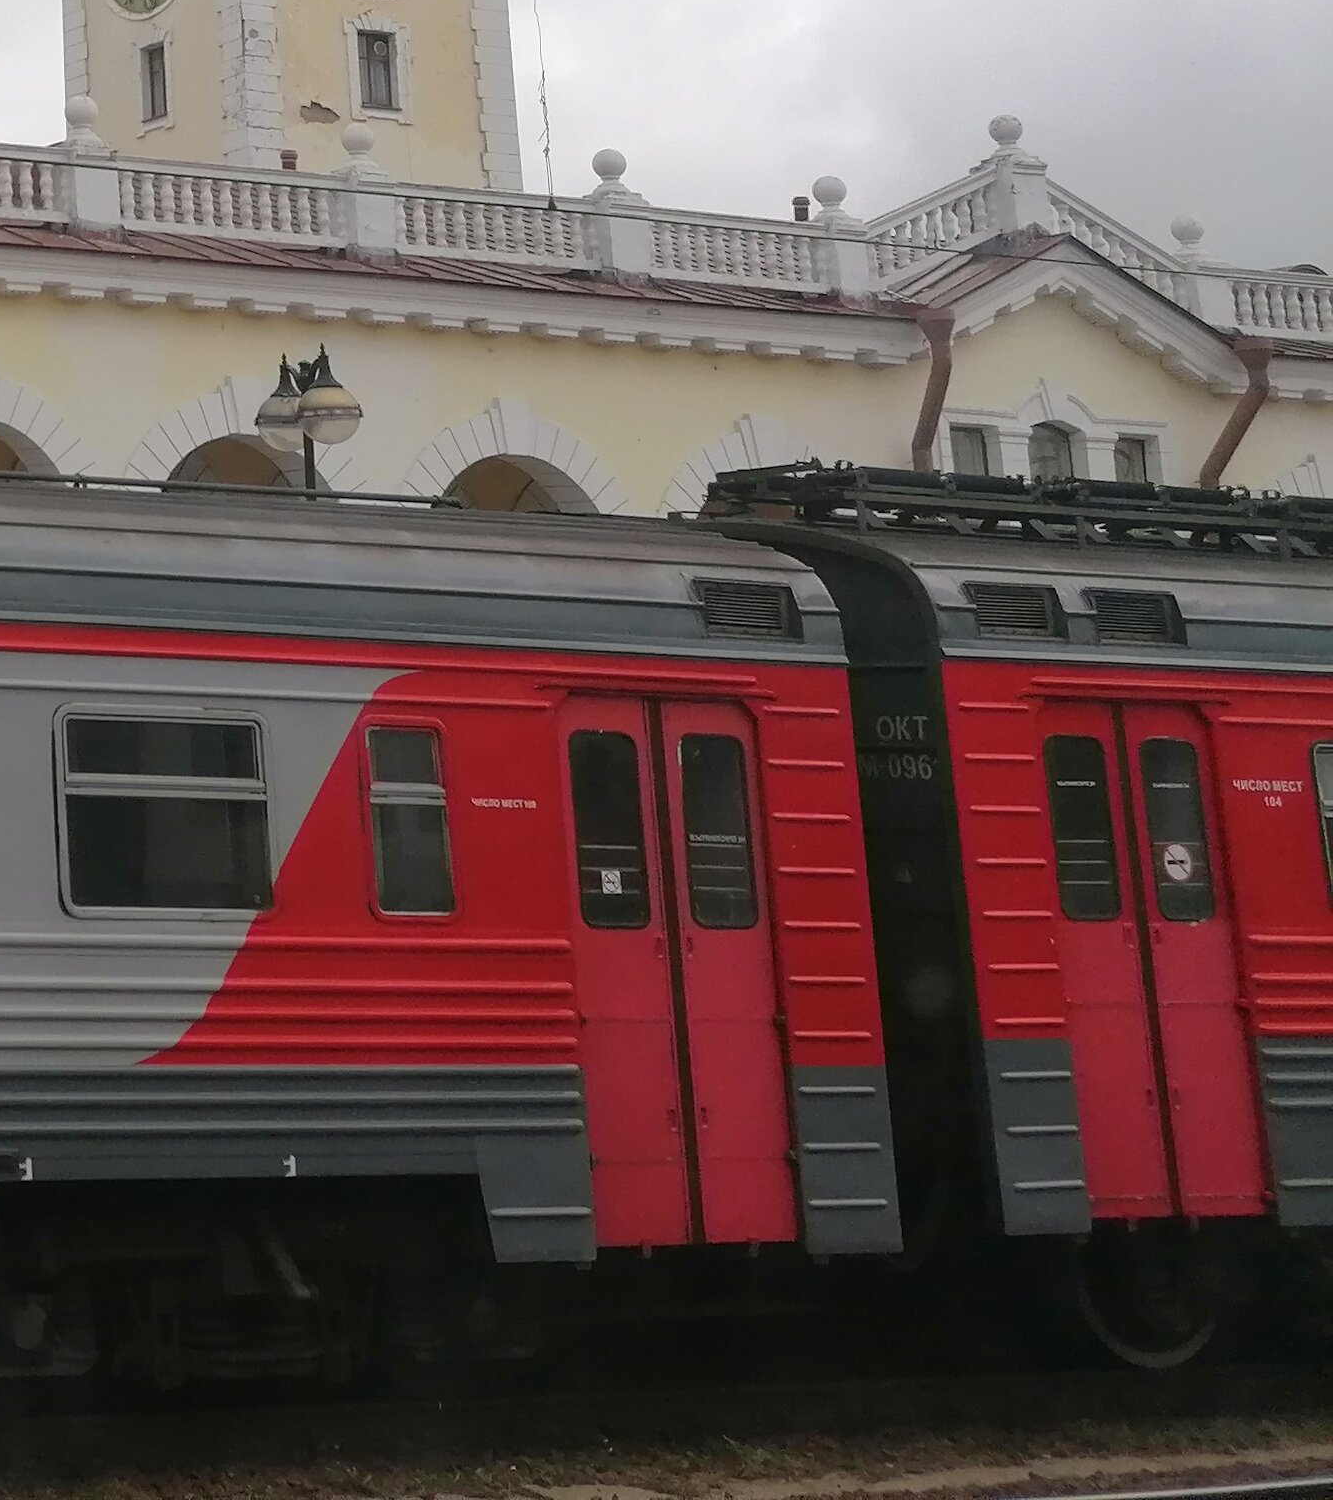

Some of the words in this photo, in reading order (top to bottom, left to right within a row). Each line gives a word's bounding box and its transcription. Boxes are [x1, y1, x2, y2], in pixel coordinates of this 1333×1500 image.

[876, 716, 929, 741] ОКТ
[1232, 779, 1271, 792] ЧИСЛО
[1272, 780, 1303, 793] МЕСТ
